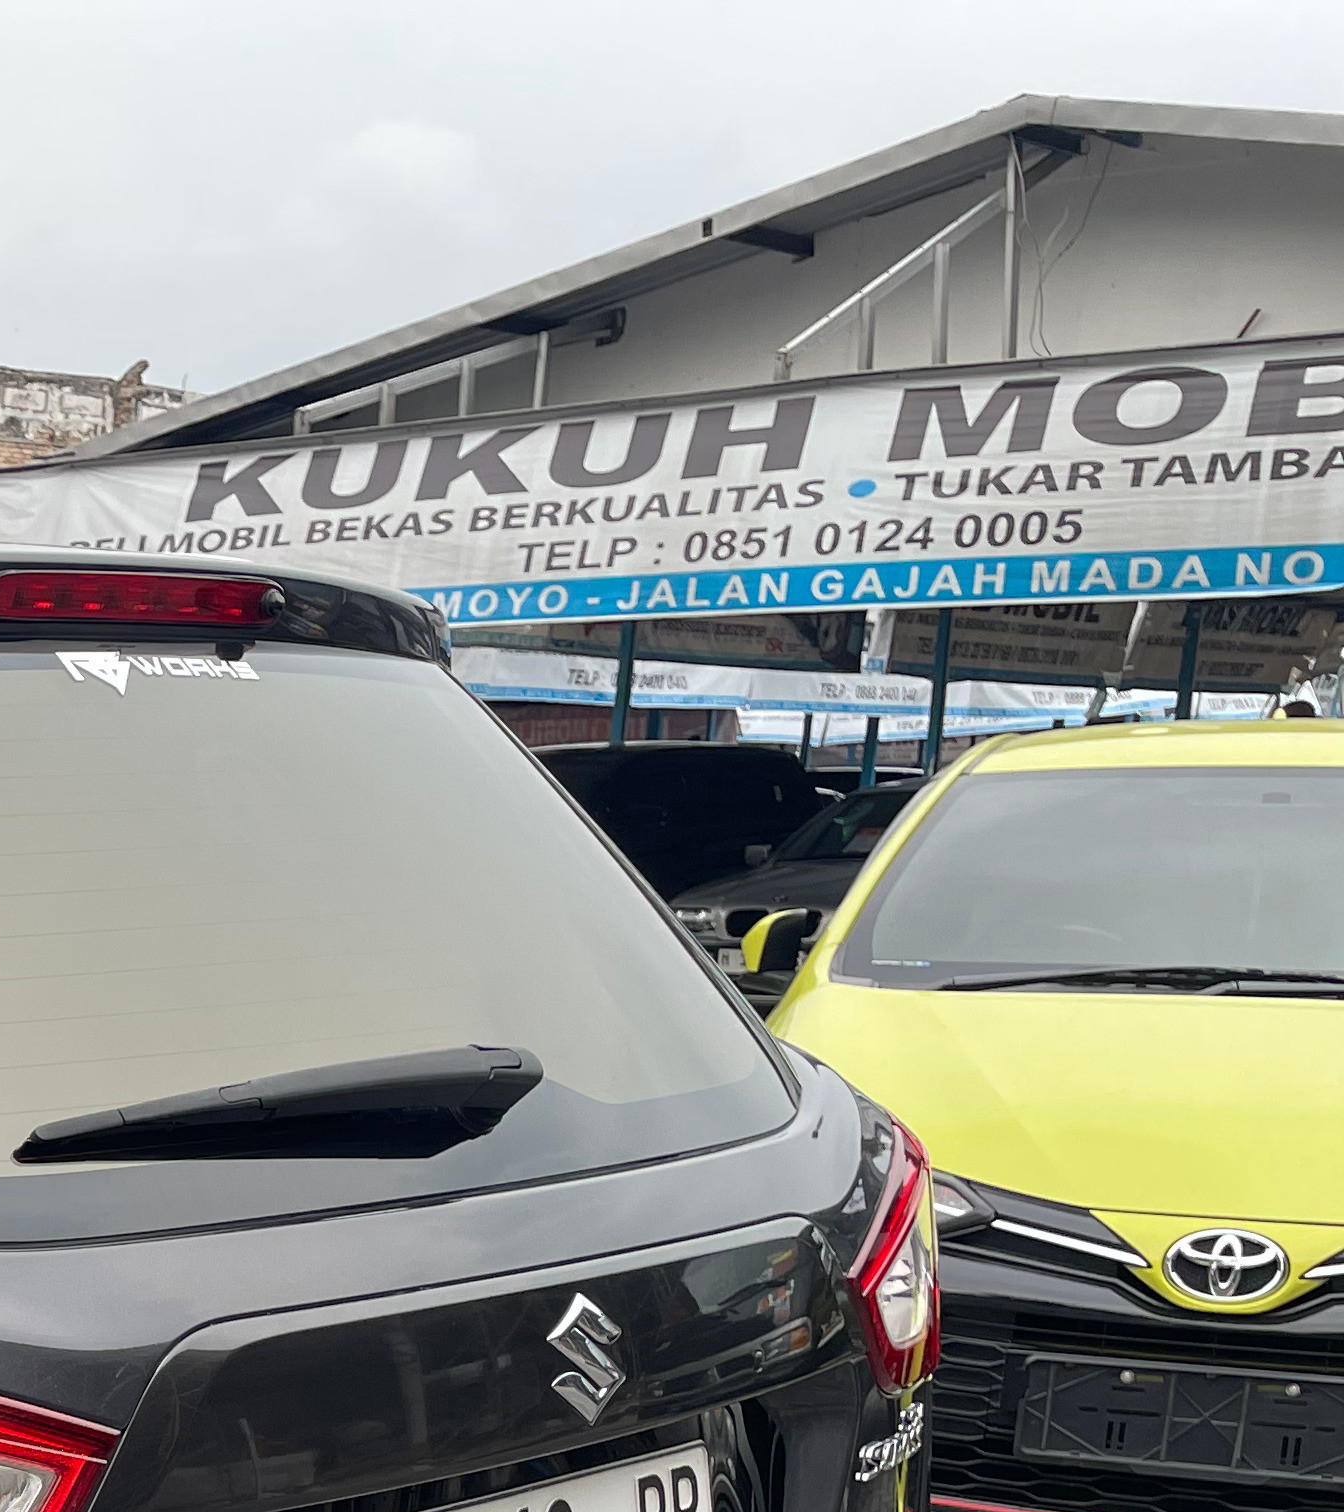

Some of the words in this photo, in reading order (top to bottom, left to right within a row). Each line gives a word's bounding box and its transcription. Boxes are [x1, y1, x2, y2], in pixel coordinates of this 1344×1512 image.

[184, 395, 817, 522] KUKUH
[157, 523, 291, 554] MOBIL
[305, 507, 454, 544] BEKAS
[469, 478, 826, 533] BERKUALITAS
[896, 460, 1105, 502] TUKAR
[519, 537, 639, 574] TELP
[683, 523, 792, 565] 0851
[815, 516, 935, 557] 0124
[954, 507, 1085, 548] 0005
[615, 570, 790, 612] JALAN
[811, 560, 1007, 603] GAJAH
[1030, 553, 1212, 595] MADA
[1234, 549, 1326, 586] NO
[126, 655, 260, 681] WORKS
